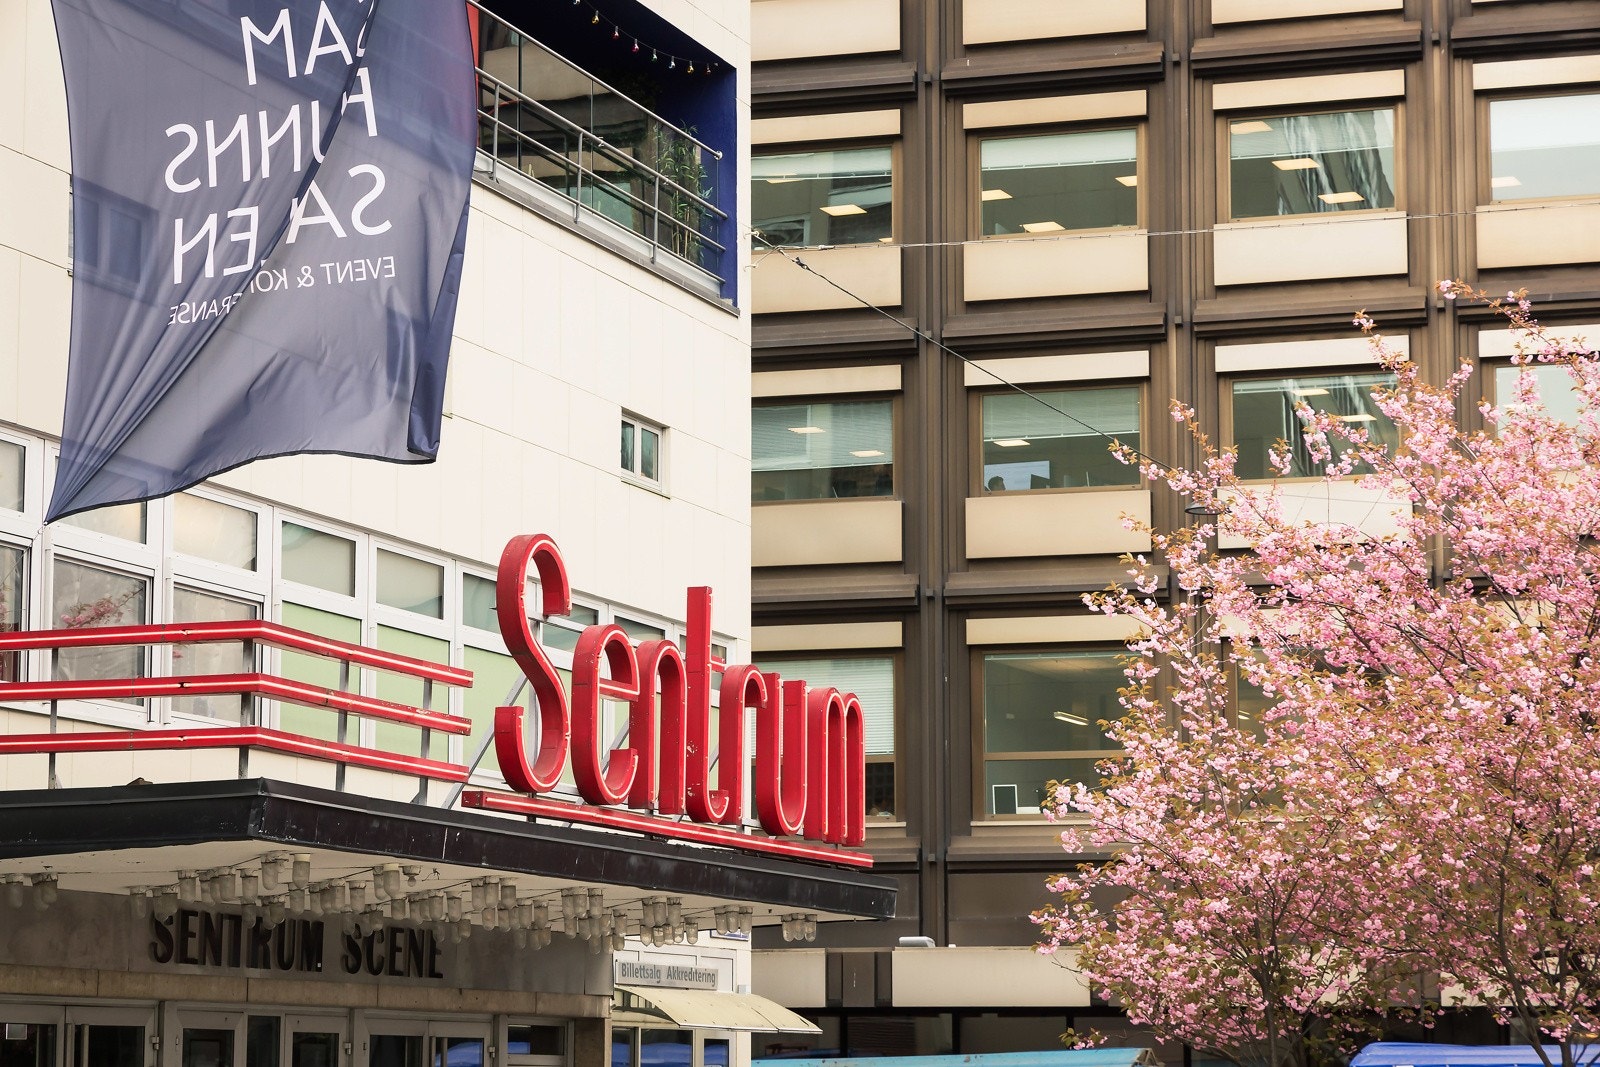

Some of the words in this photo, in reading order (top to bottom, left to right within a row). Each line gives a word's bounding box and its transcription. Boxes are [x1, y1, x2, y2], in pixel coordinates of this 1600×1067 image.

[495, 533, 866, 847] Sentrum
[150, 908, 324, 973] SENTRUM
[342, 922, 443, 979] SCENE
[621, 962, 662, 983] Billettsalg
[666, 966, 716, 987] Akkreditering
